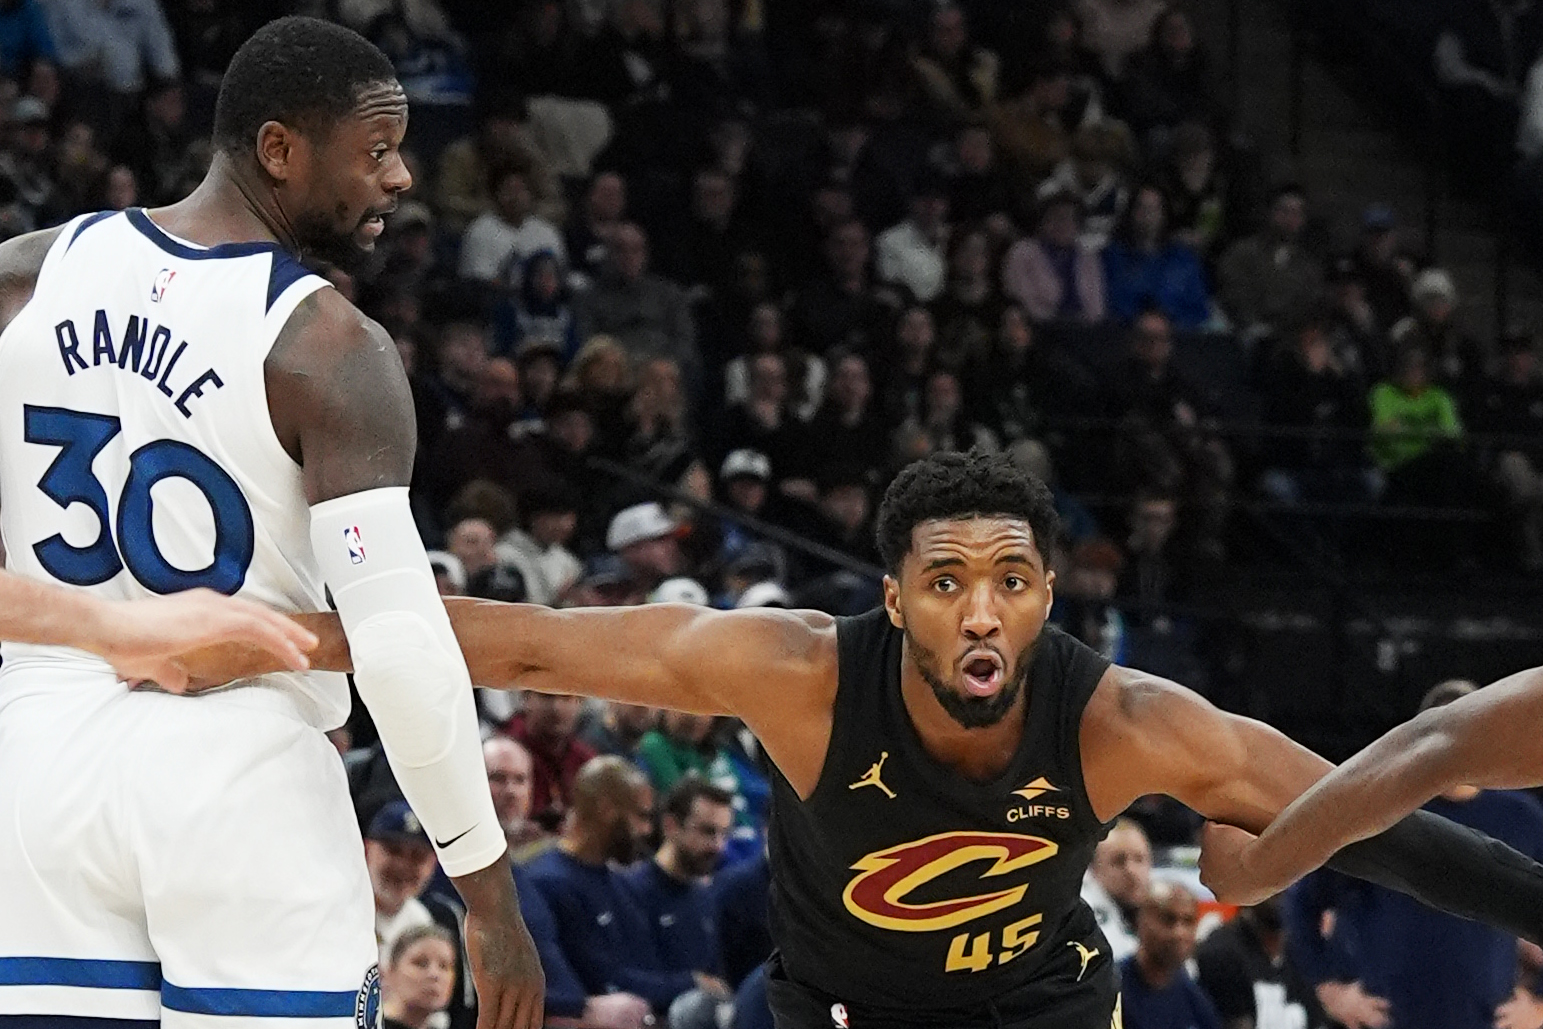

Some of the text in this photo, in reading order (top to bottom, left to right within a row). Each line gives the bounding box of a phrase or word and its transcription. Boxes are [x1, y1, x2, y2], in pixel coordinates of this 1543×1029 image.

[55, 309, 224, 419] RANDLE
[23, 403, 255, 595] 30
[1006, 805, 1070, 823] CLIFFS
[944, 912, 1044, 974] 45
